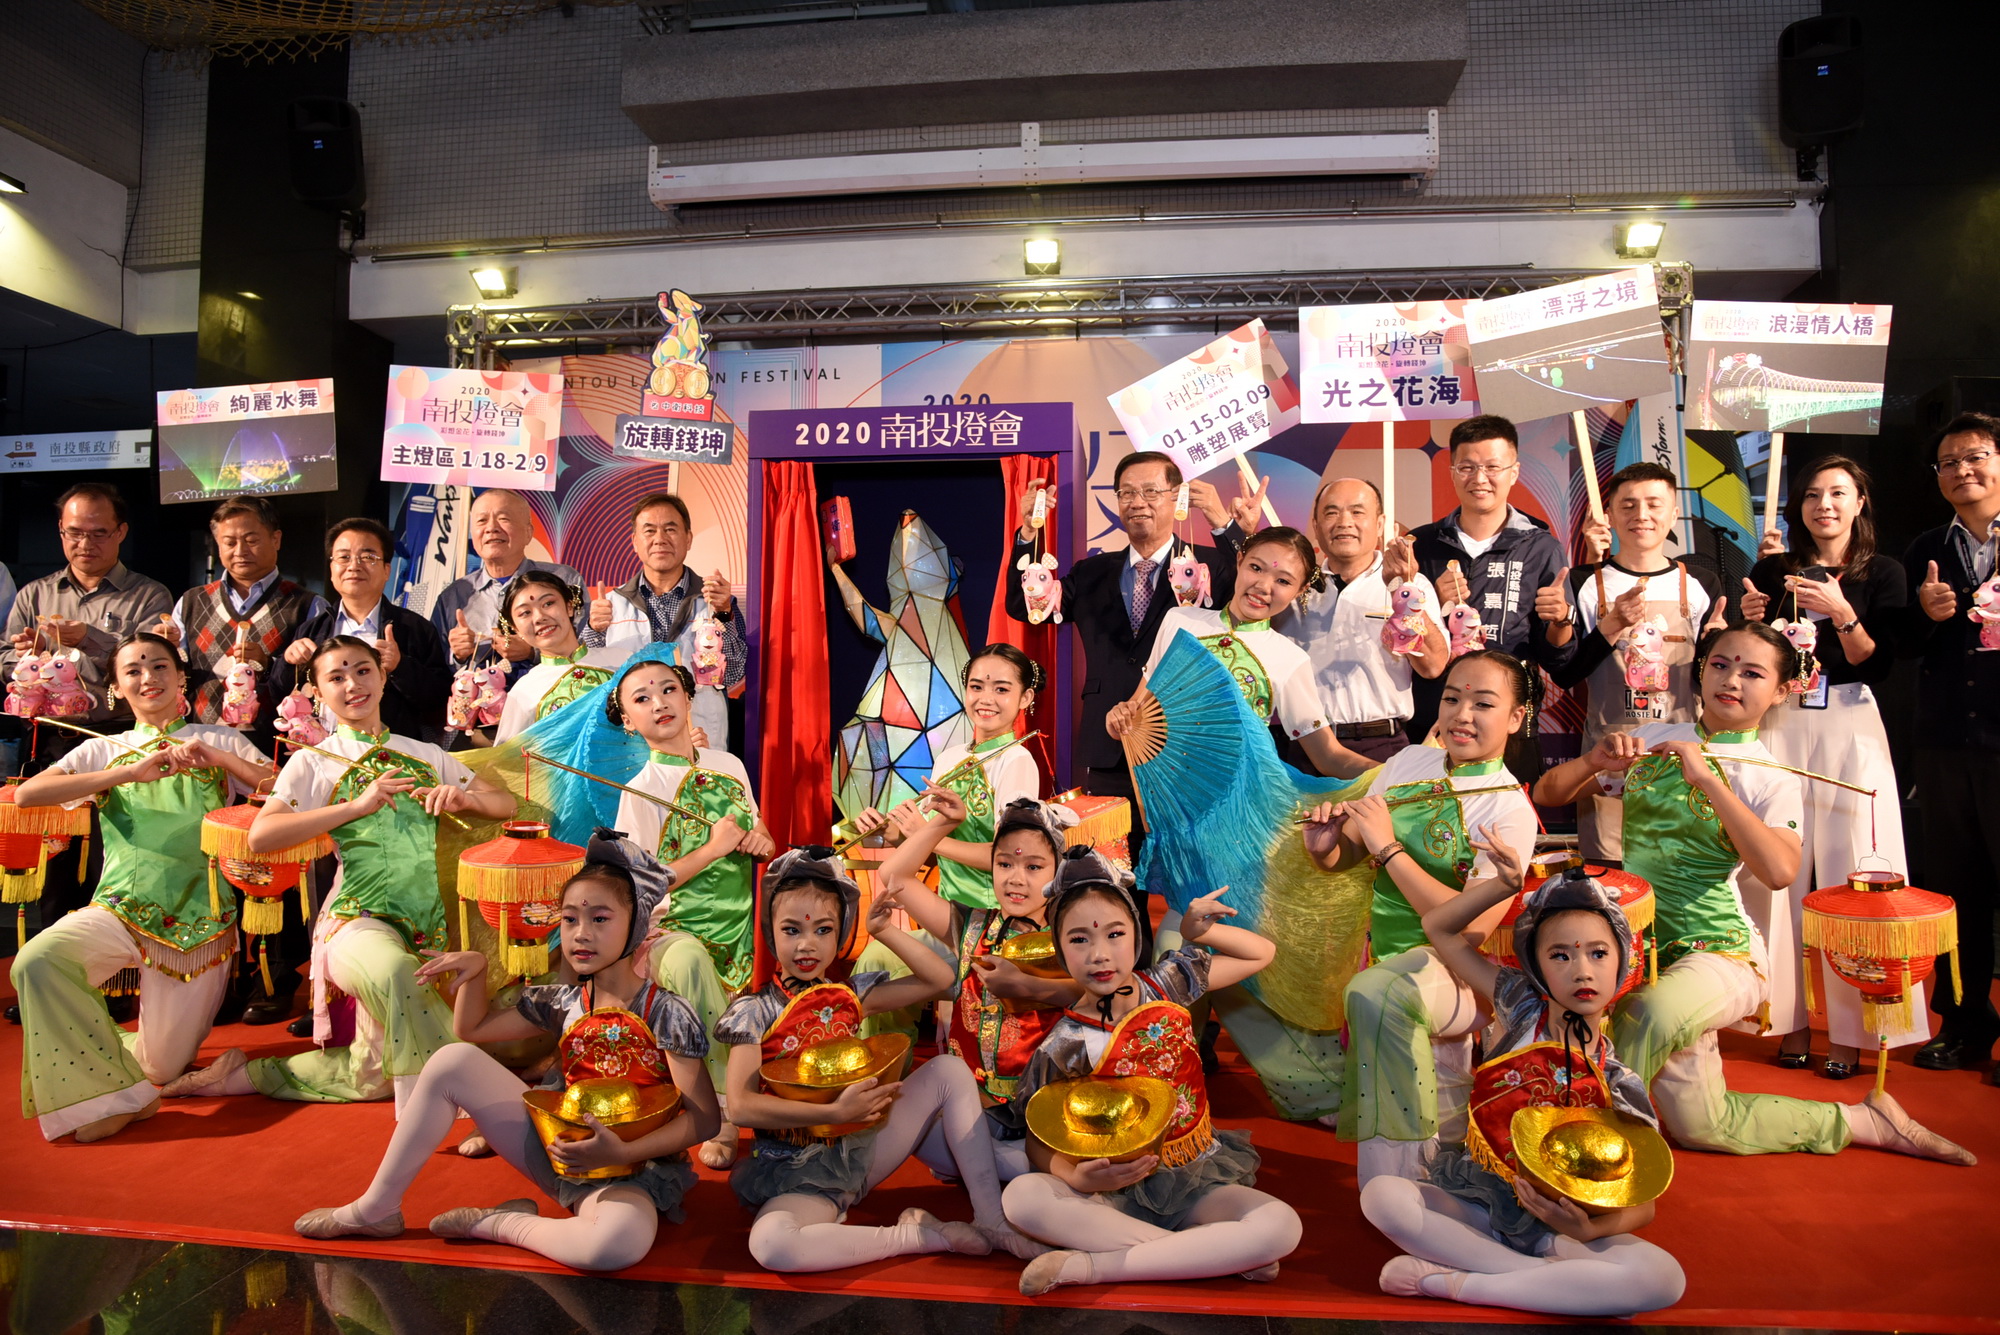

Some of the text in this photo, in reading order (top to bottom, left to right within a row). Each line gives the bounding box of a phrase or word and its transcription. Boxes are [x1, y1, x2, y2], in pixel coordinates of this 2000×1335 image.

[1542, 280, 1638, 319] 漂浮之境
[1375, 318, 1406, 327] 2020
[1704, 315, 1760, 331] 南投燈會
[1768, 314, 1874, 336] 浪漫情人橋
[1337, 330, 1444, 358] 南投燈會
[564, 376, 617, 390] NTOU
[741, 368, 841, 384] FESTIVAL
[1182, 366, 1203, 380] 2020
[230, 389, 318, 414] 絢麗水舞
[461, 386, 491, 396] 2020
[1163, 364, 1234, 411] 南投燈會
[1322, 375, 1460, 408] 光之花海
[169, 400, 220, 416] 南投燈會
[422, 398, 524, 428] 南投燈會
[1162, 384, 1270, 449] 01.15-02.09
[624, 423, 724, 456] 旋轉錢坤
[795, 410, 1024, 449] 2020 南投燈會
[1186, 410, 1271, 465] 雕塑展覽
[1652, 416, 1671, 471] storm
[50, 440, 120, 455] 南投縣政府
[392, 445, 547, 472] 主燈區 1/18-2/9
[435, 485, 457, 567] Waves
